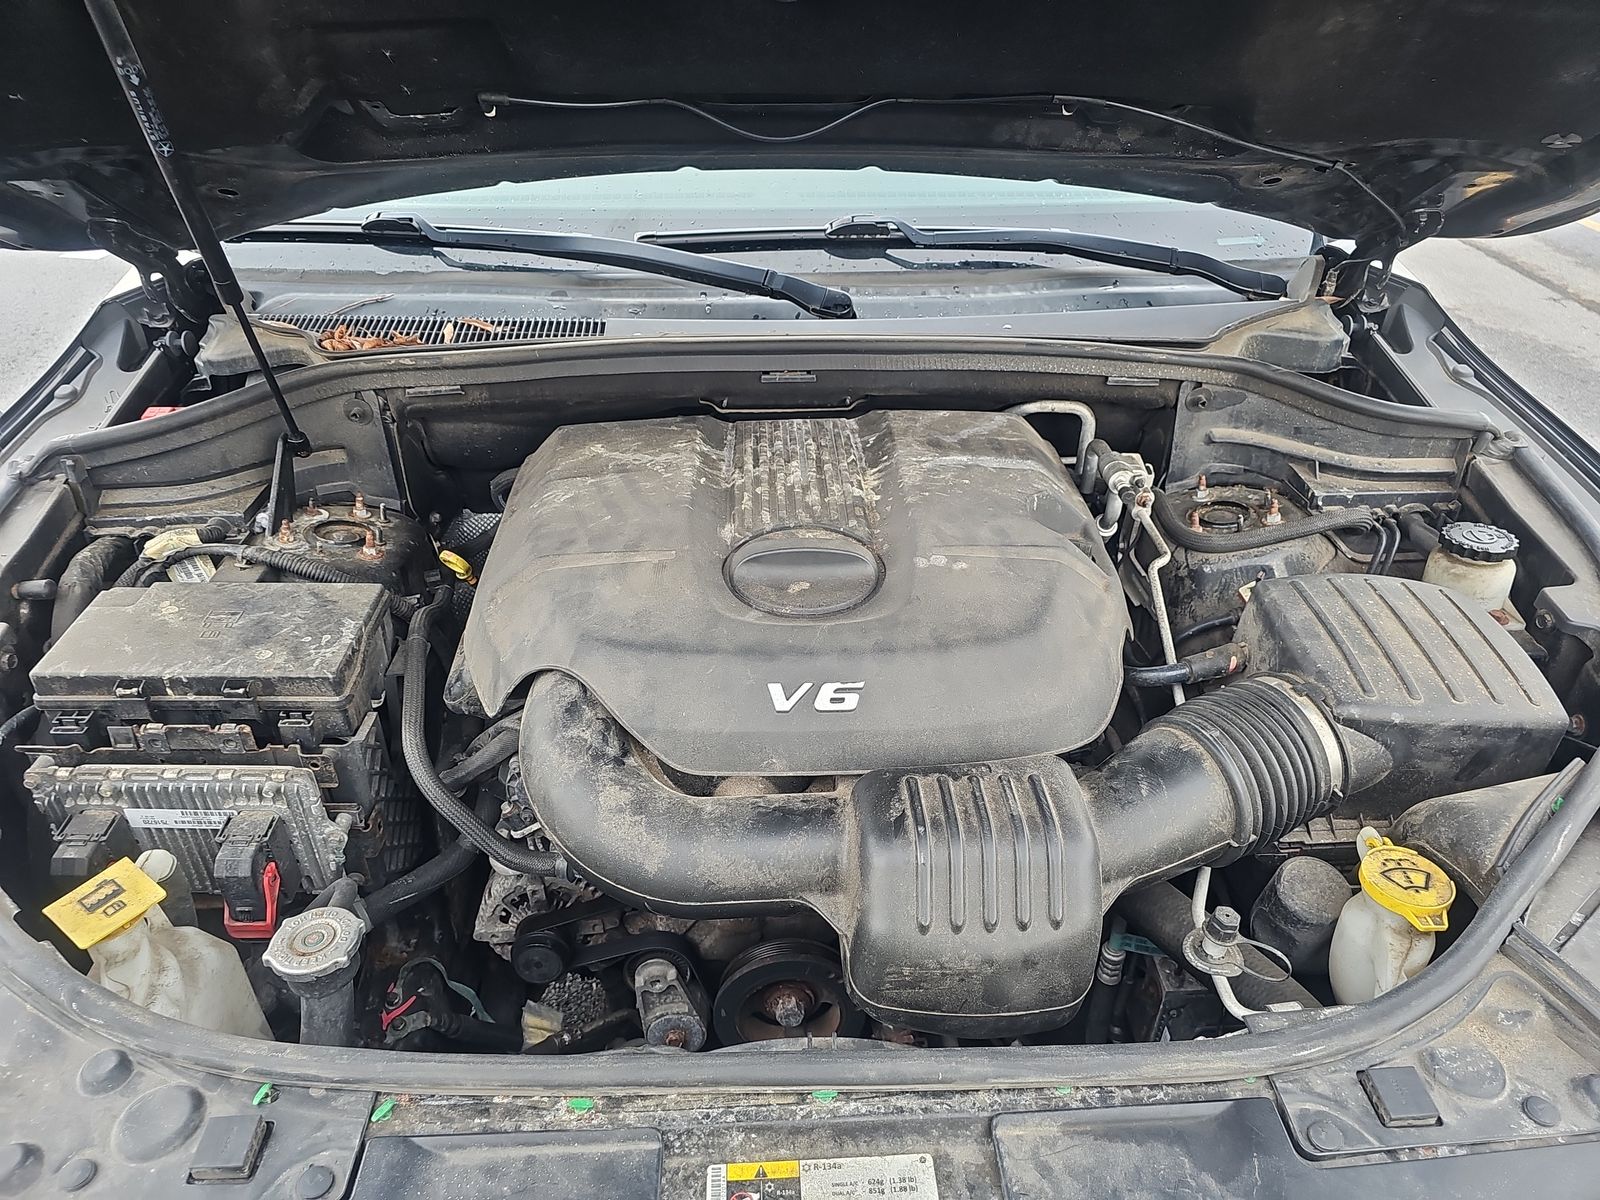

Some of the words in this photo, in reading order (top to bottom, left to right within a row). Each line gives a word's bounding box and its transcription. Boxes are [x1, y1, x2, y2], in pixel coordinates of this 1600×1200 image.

[767, 680, 865, 713] V6
[294, 953, 327, 967] KEEP
[813, 1162, 842, 1171] R-134a
[867, 1178, 885, 1186] 624g
[868, 1187, 886, 1196] 851g
